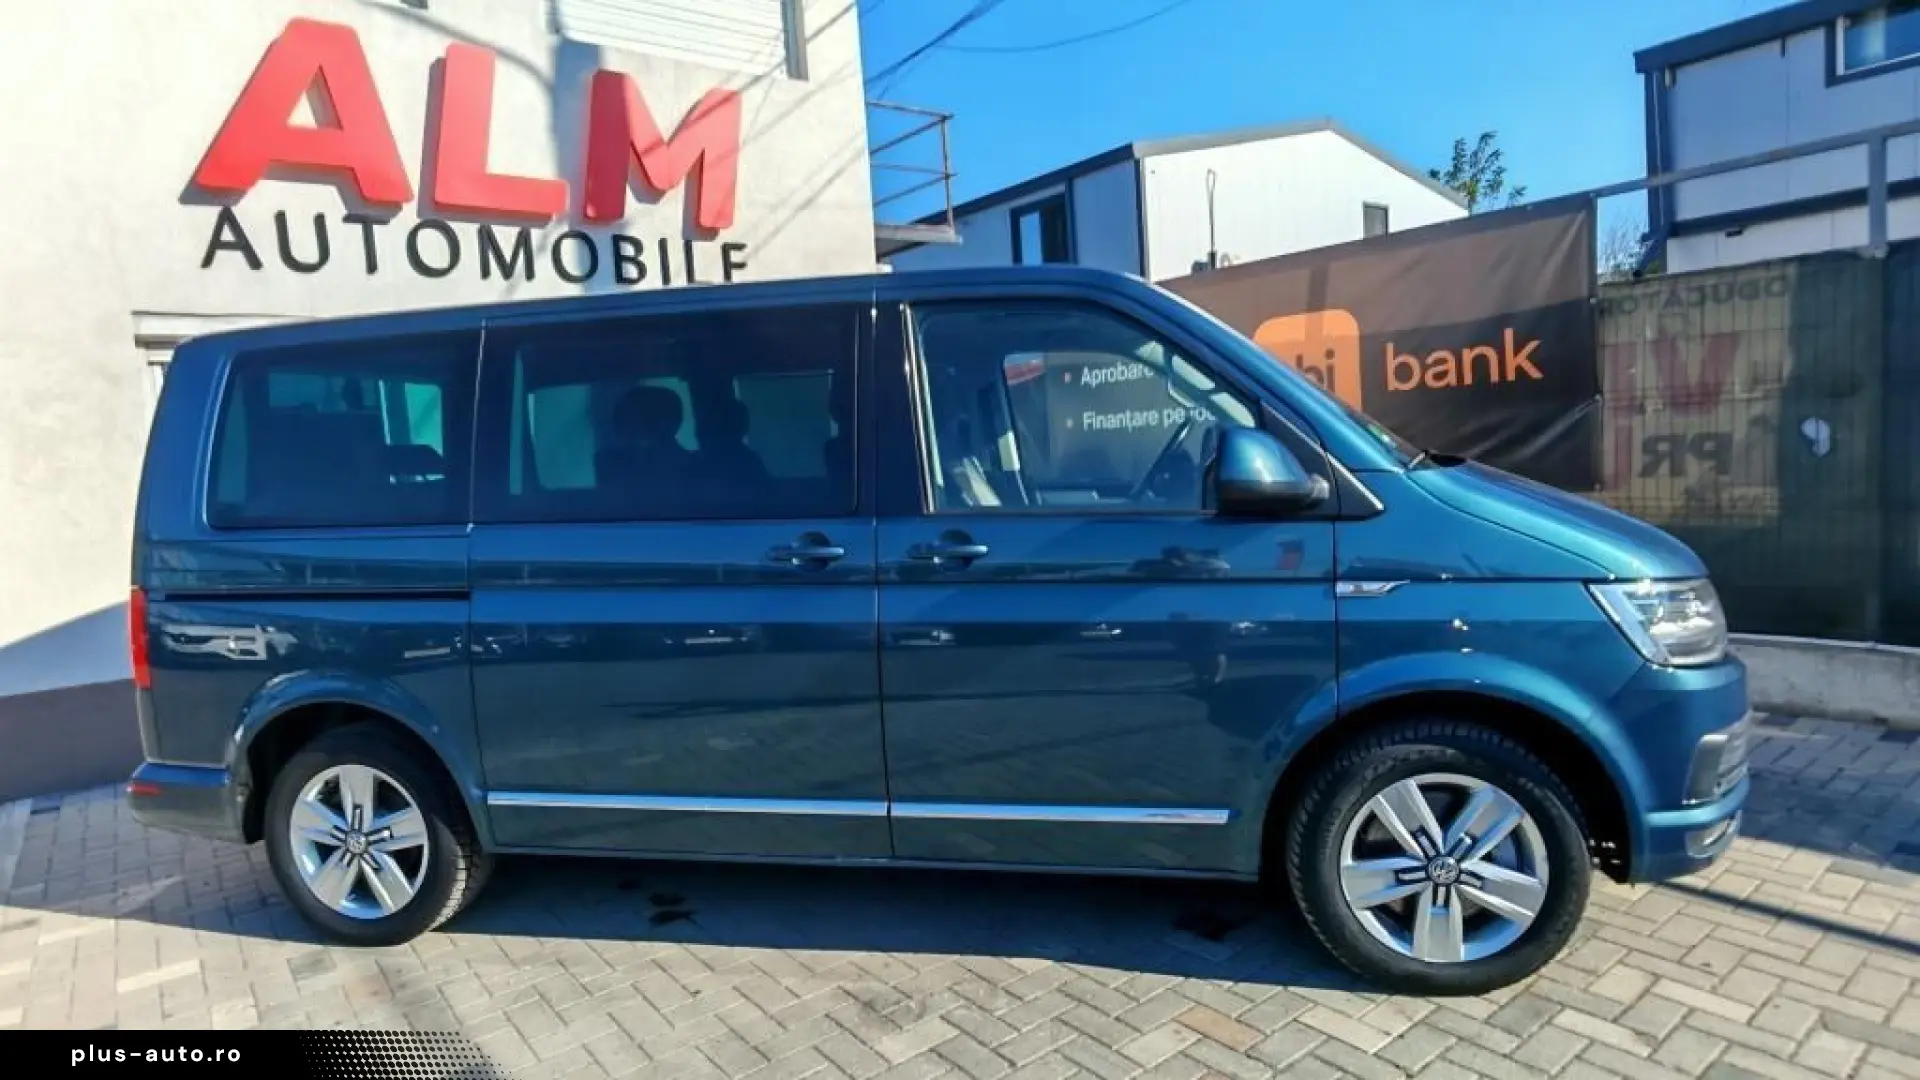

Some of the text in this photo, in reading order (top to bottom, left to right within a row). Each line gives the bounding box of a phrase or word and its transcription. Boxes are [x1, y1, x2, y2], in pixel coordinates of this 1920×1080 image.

[193, 17, 742, 229] ALM
[1384, 328, 1544, 391] bank
[1082, 407, 1159, 433] Finanțare
[1163, 406, 1186, 429] pe
